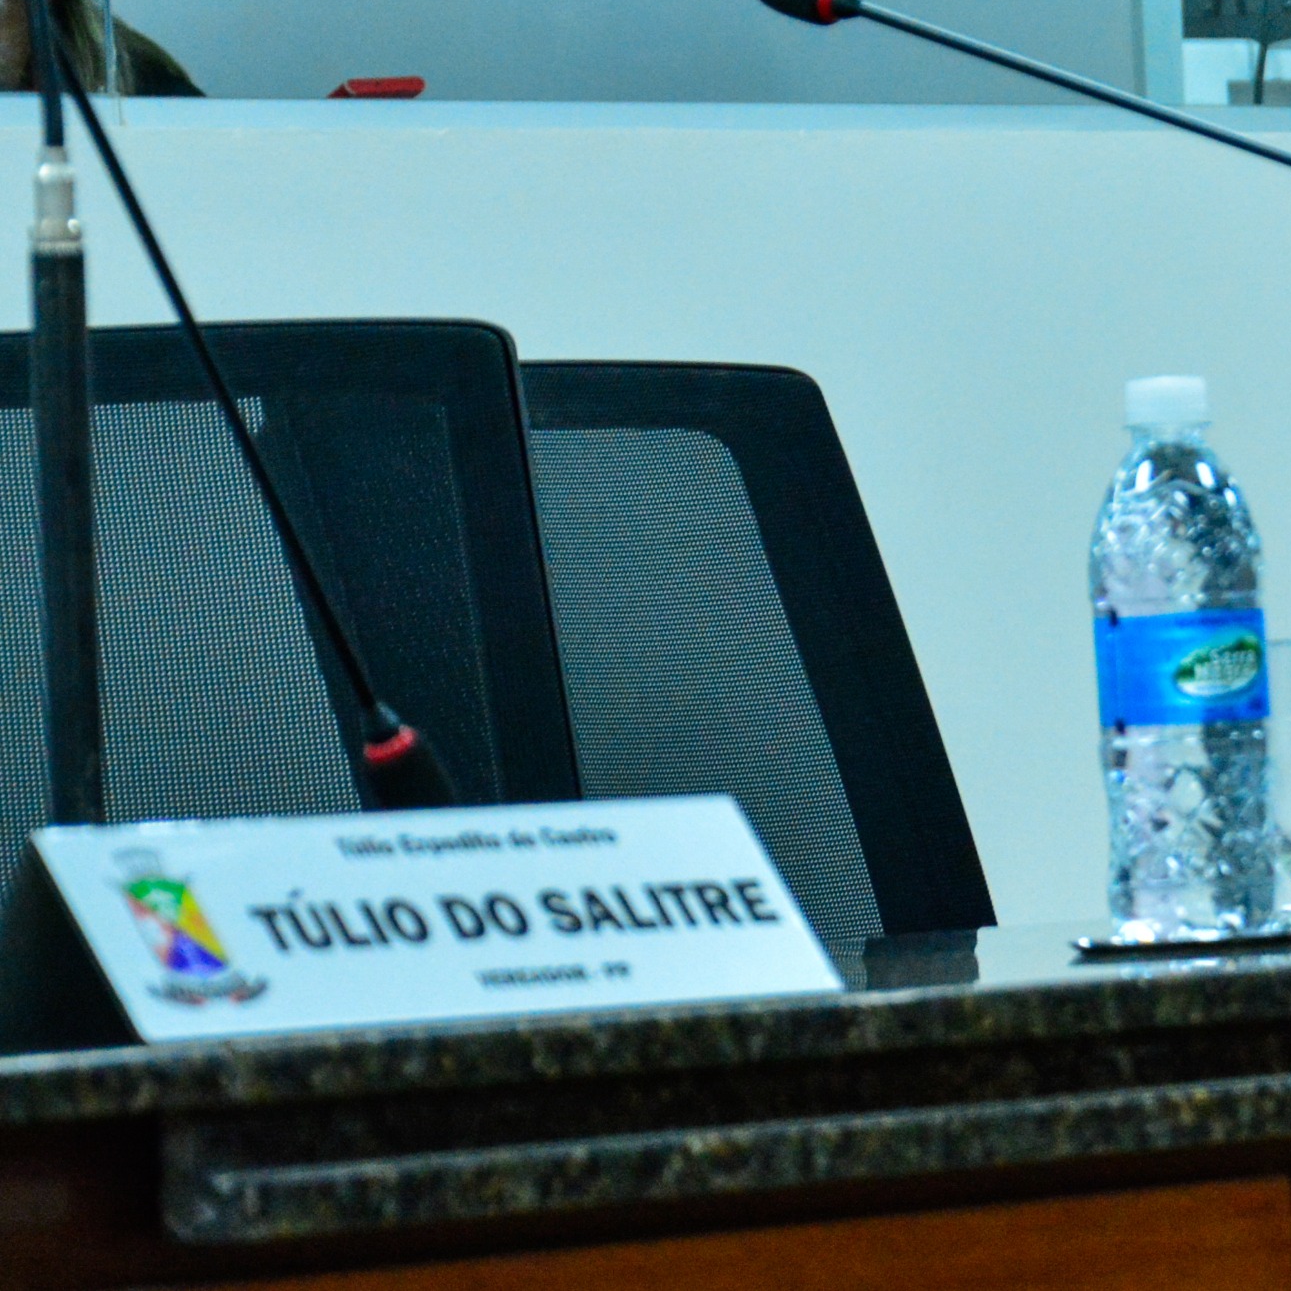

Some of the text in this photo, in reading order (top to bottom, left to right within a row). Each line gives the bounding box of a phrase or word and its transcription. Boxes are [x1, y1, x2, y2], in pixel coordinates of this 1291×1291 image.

[252, 876, 778, 952] TÚLIO DO SALITRE
